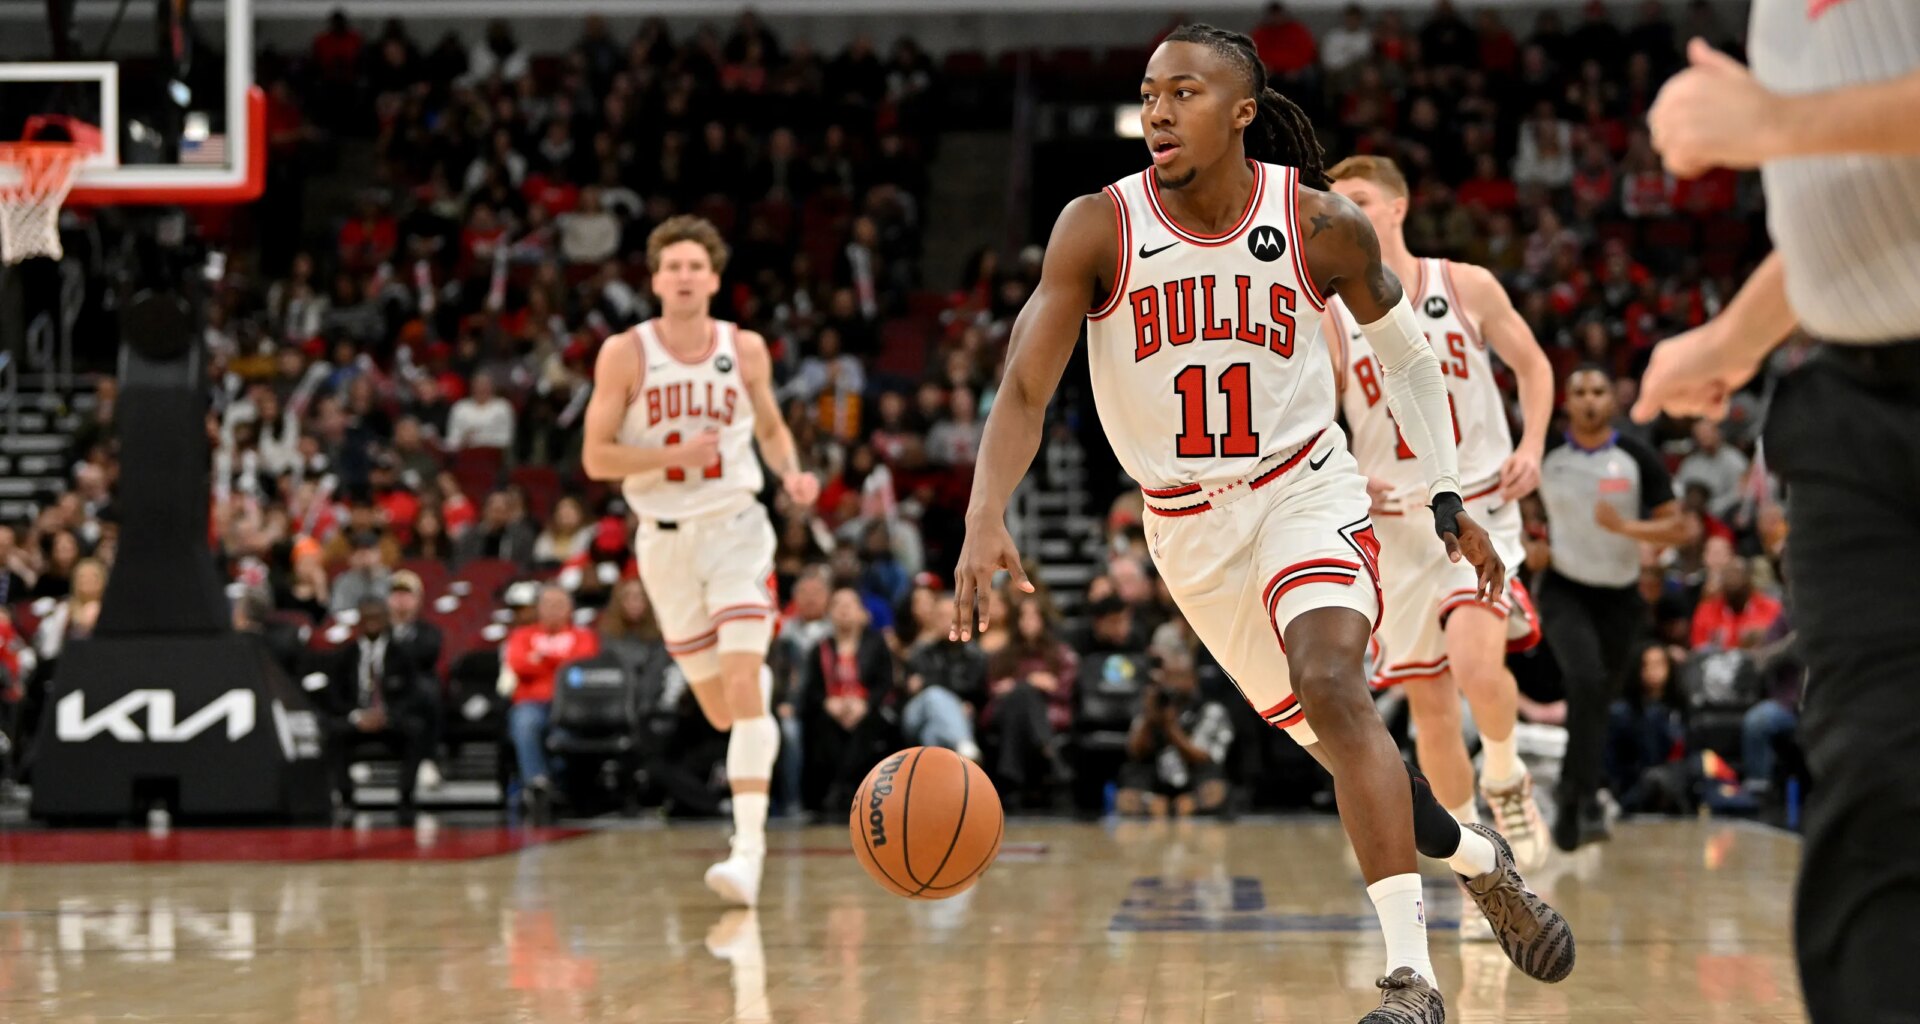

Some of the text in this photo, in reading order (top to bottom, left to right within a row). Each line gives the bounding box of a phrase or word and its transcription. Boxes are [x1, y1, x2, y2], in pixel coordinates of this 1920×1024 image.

[1129, 274, 1297, 363] BULLS
[646, 380, 738, 427] BULLS
[1174, 362, 1260, 459] 11
[56, 688, 256, 742] KIA
